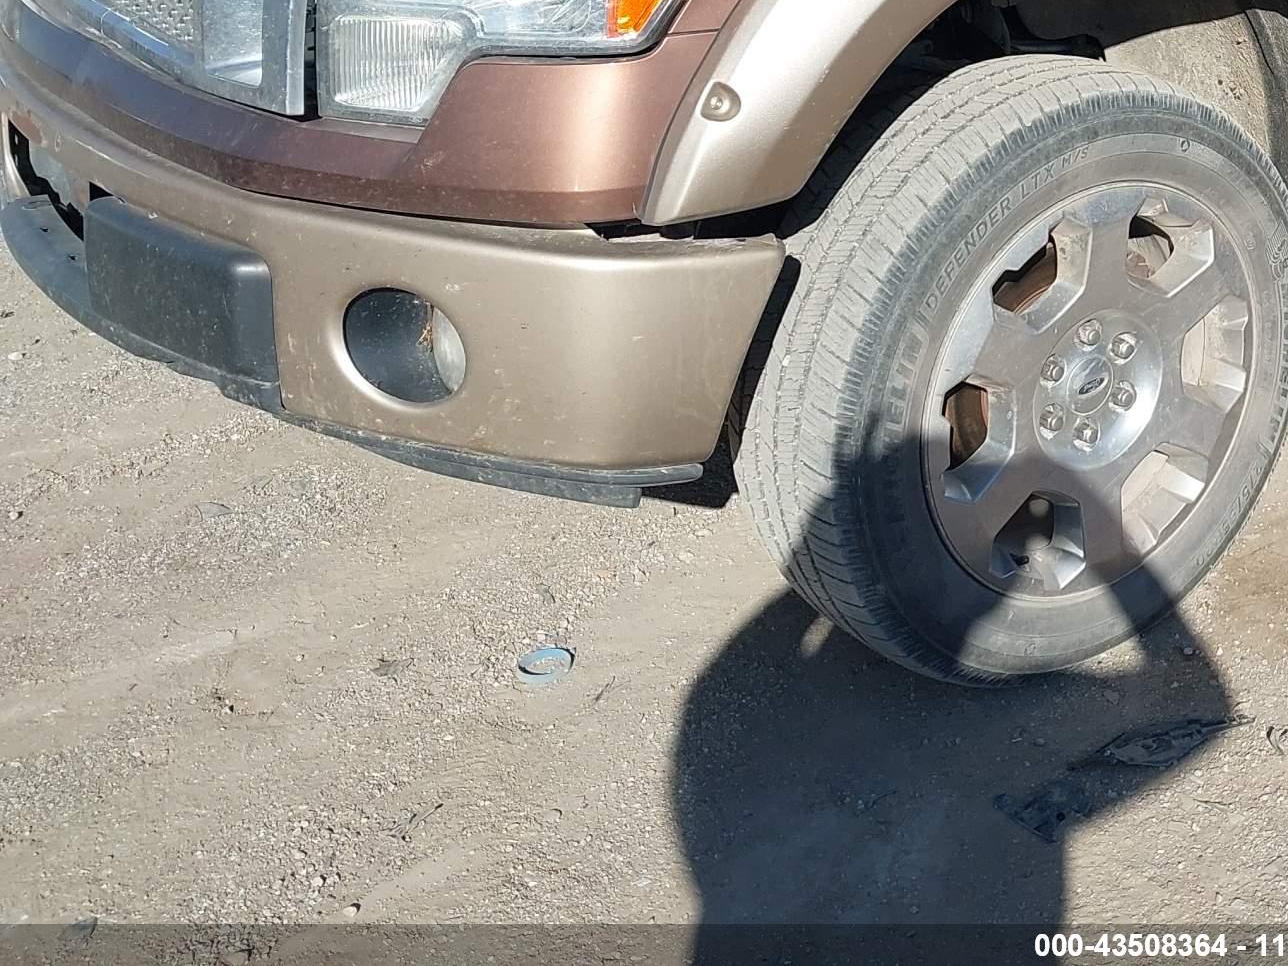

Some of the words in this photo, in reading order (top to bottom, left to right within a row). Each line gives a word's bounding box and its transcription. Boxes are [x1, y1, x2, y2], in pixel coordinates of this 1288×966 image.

[926, 196, 1013, 311] DEFENDER
[1020, 163, 1056, 200] LTX
[1061, 145, 1092, 168] M/S
